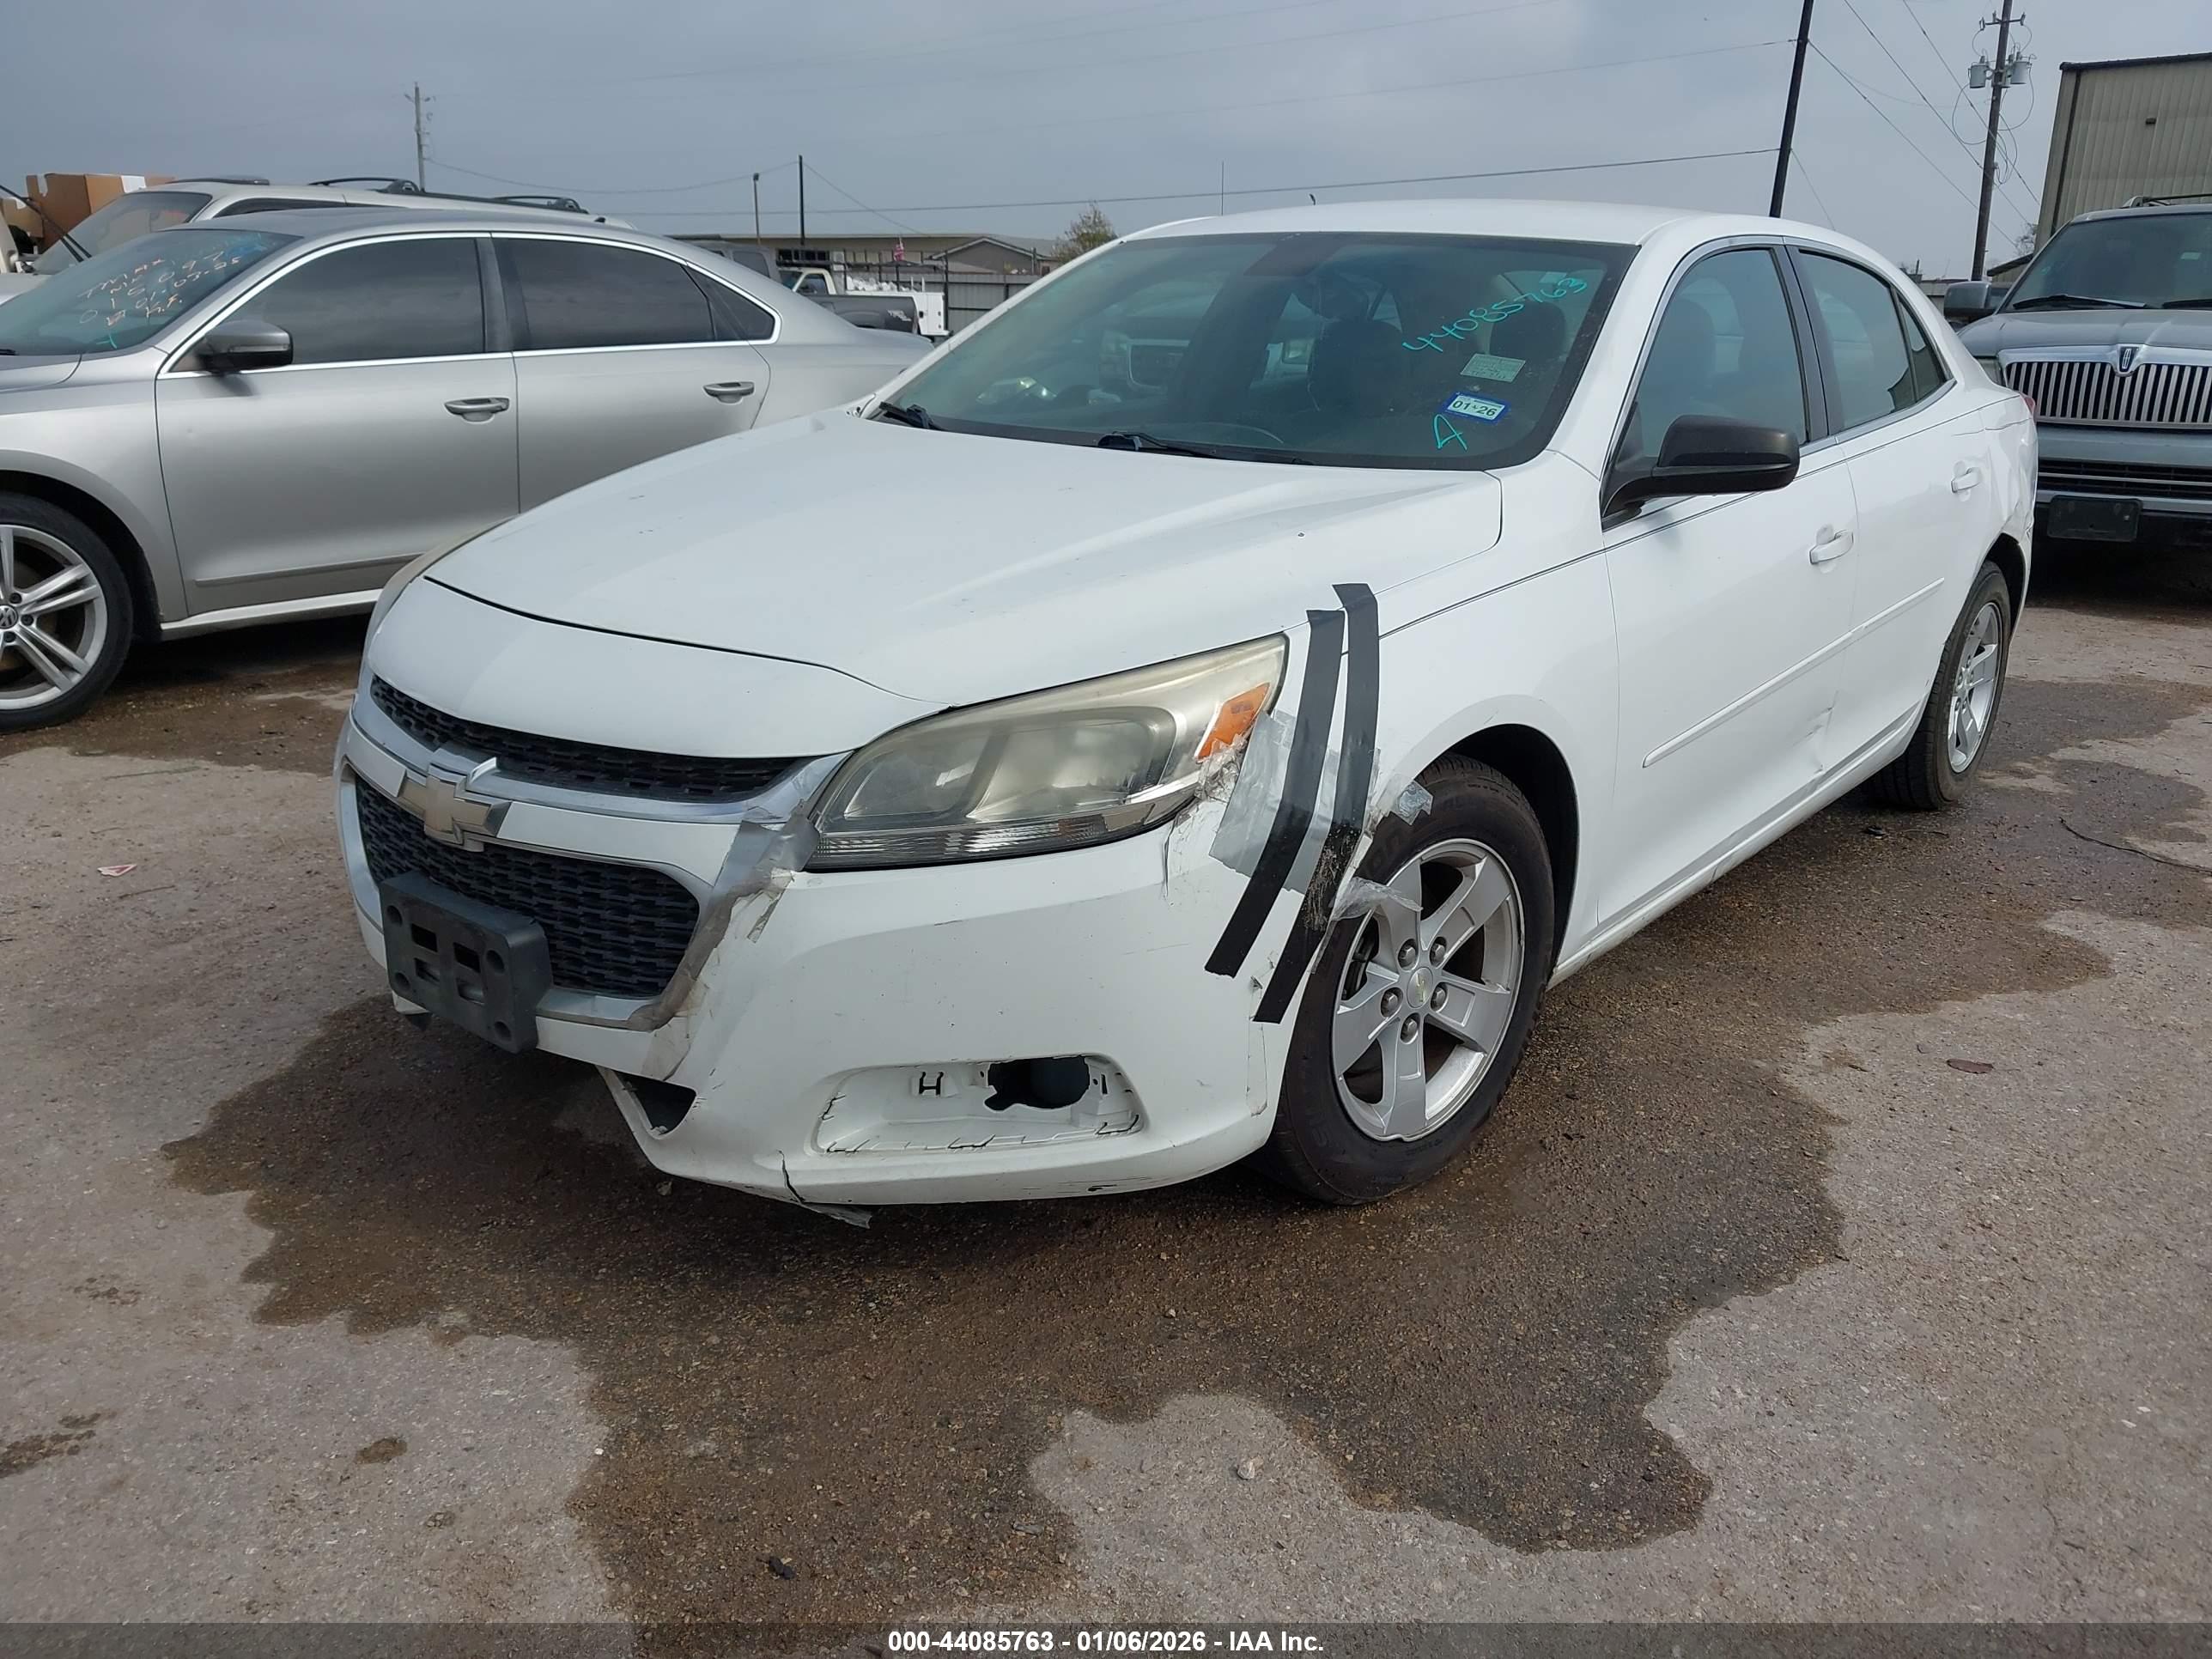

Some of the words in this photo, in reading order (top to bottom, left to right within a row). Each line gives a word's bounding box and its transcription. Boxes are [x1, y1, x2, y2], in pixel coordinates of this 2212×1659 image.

[1401, 276, 1587, 353] 44085763
[1452, 400, 1471, 410] 01
[1476, 405, 1498, 416] 26
